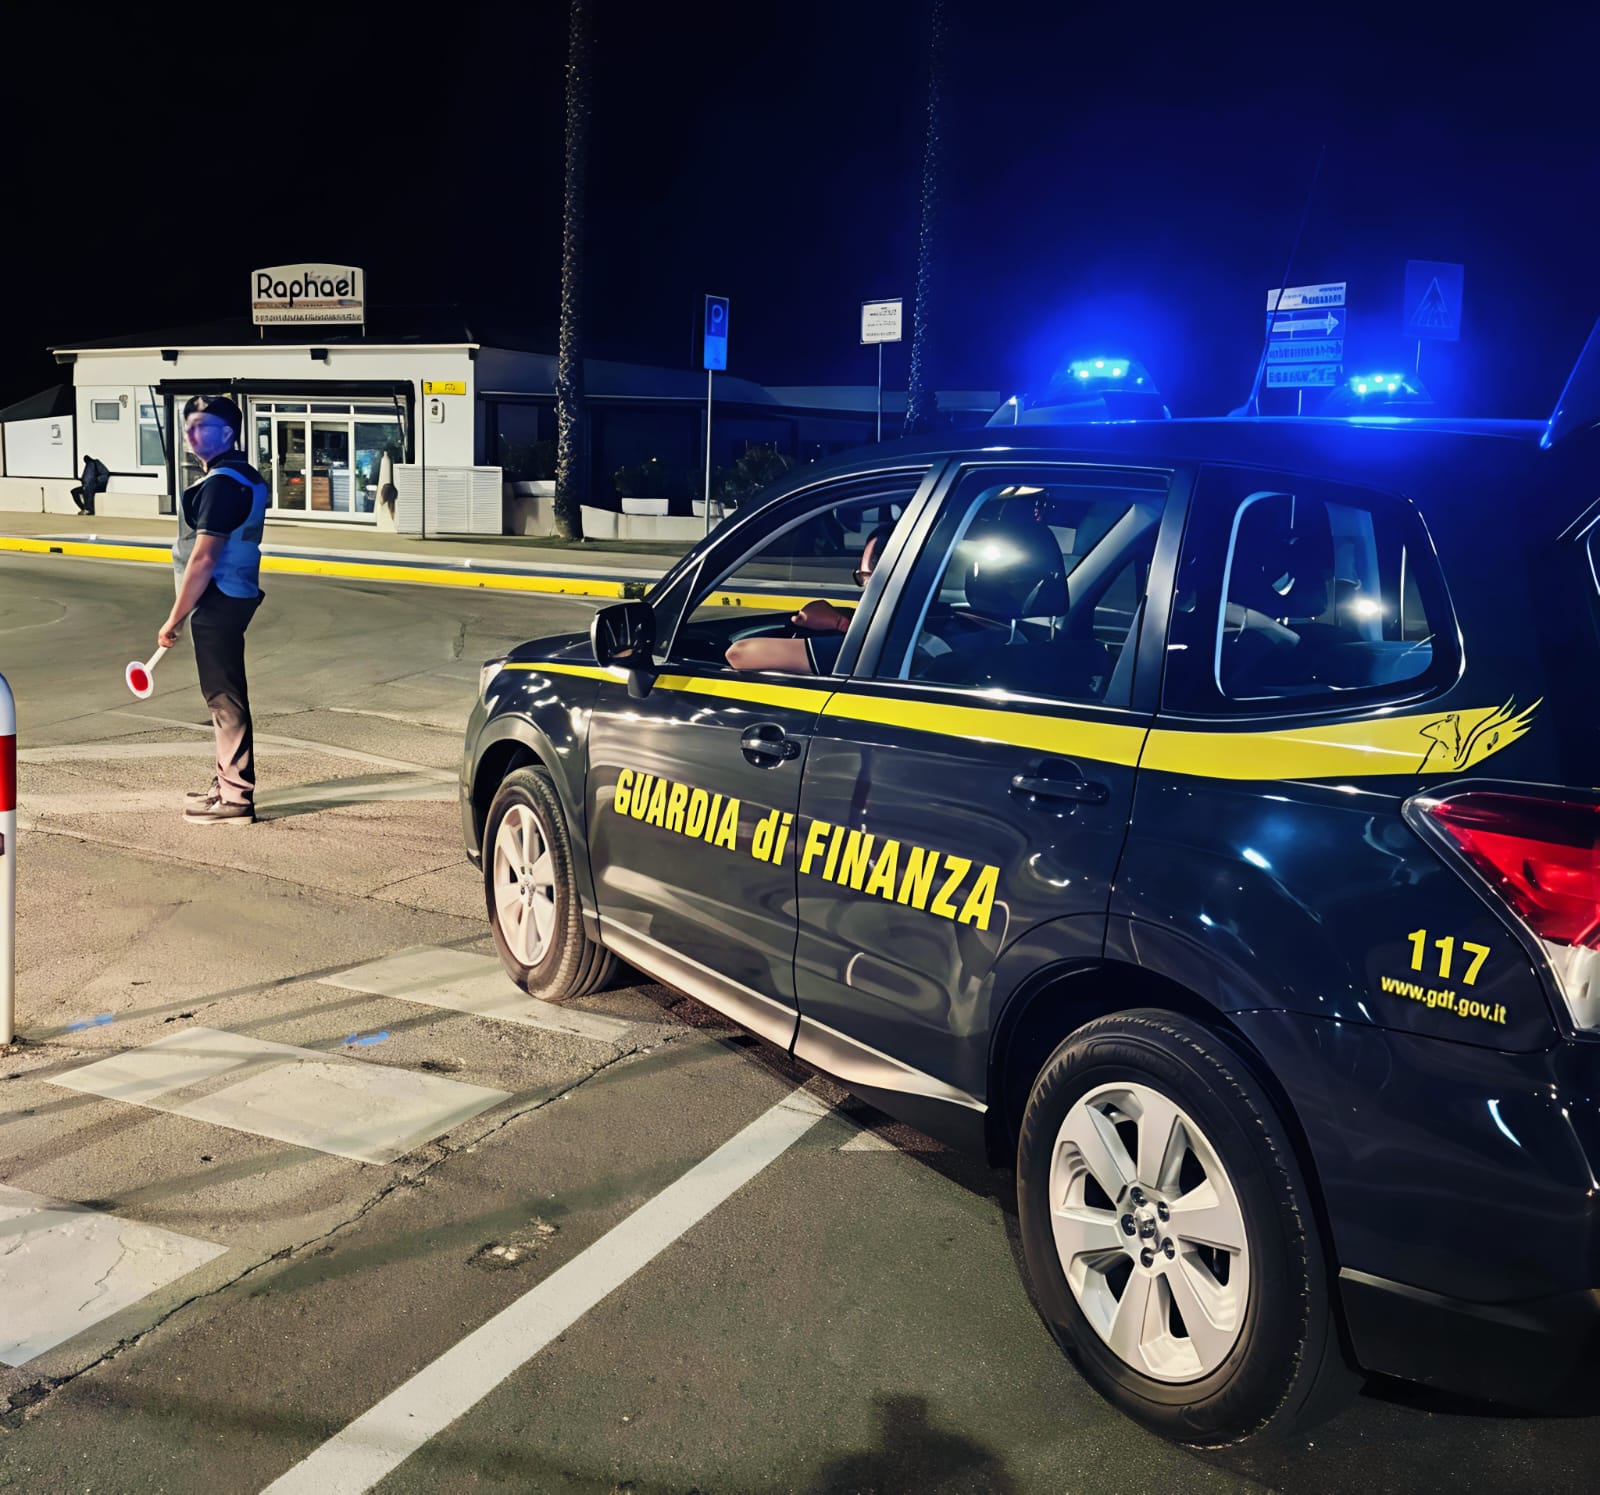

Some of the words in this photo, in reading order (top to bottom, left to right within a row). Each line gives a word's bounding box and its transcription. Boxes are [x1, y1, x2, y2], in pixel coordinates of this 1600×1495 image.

[257, 270, 355, 307] Raphael
[613, 767, 741, 851] GUARDIA
[751, 808, 794, 866] di
[799, 819, 1000, 931] FINANZA
[1407, 929, 1491, 986] 117
[1381, 976, 1507, 1024] www.gdf.gov.it
